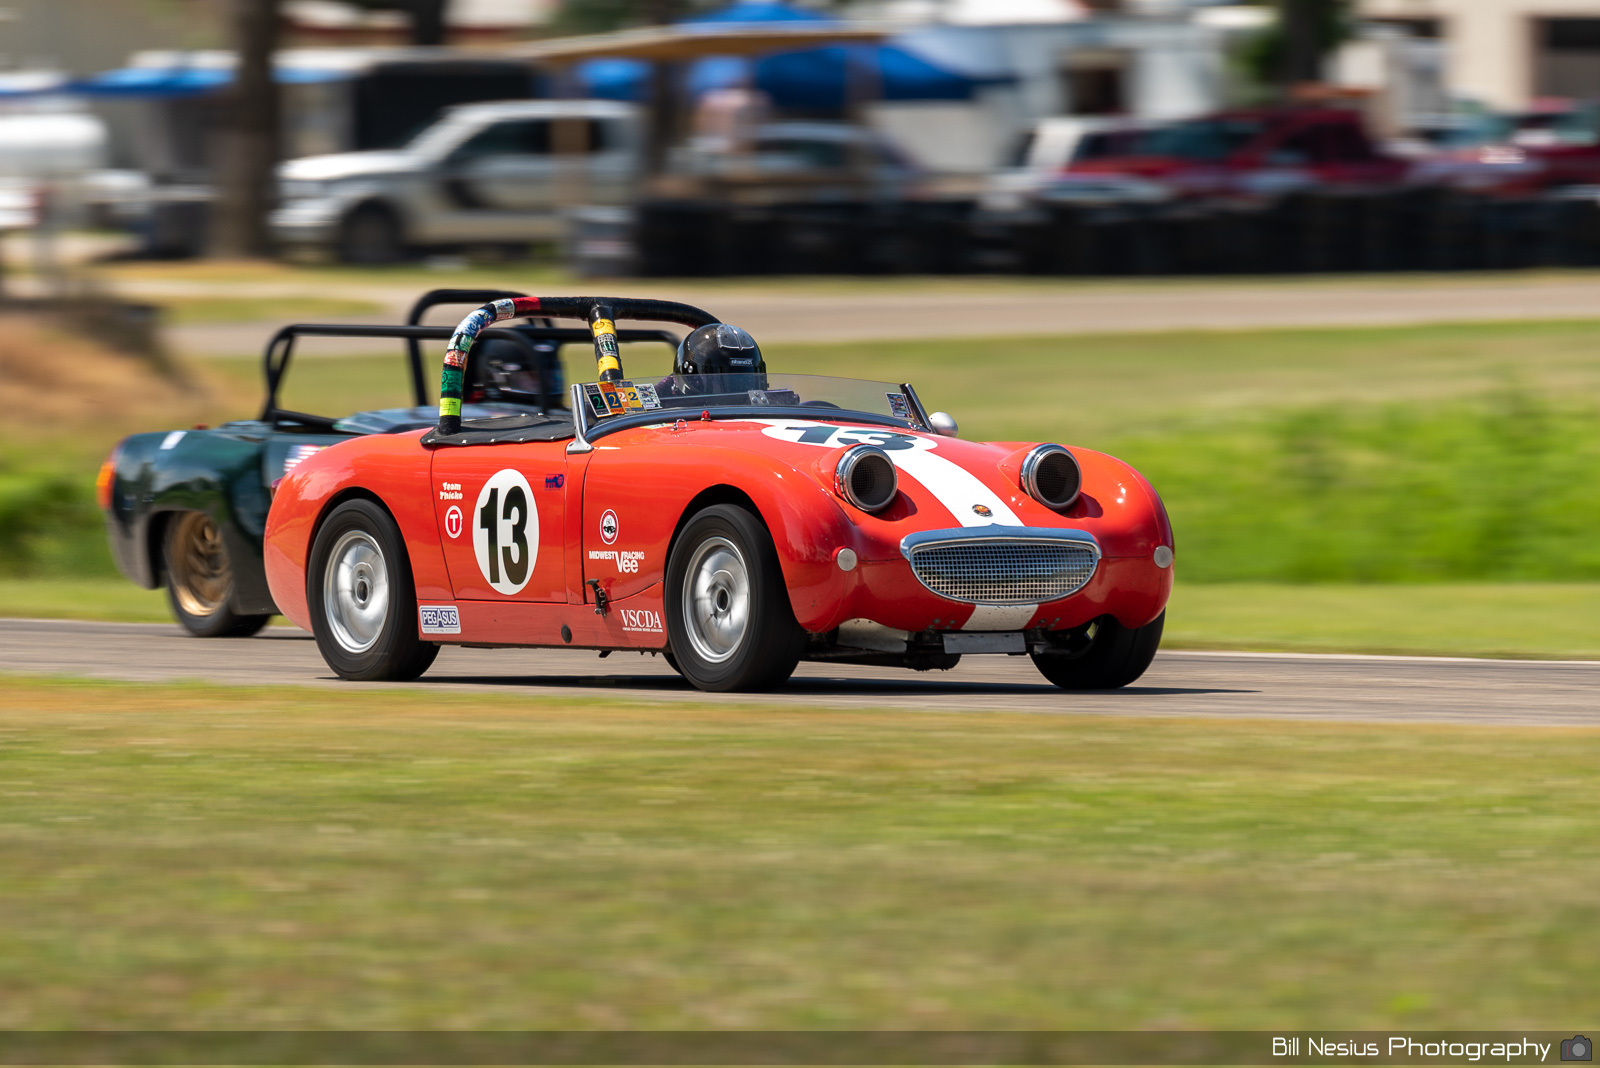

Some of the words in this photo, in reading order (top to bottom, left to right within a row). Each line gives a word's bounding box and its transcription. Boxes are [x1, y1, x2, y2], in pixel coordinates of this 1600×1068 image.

[592, 396, 604, 408] 2
[608, 394, 619, 406] 2
[618, 392, 628, 402] 2
[628, 392, 639, 401] 2
[785, 425, 918, 451] 13
[442, 482, 461, 491] Team
[450, 514, 458, 531] T
[480, 486, 529, 585] 13
[588, 550, 615, 560] MIDWEST
[623, 551, 645, 560] RACING
[614, 550, 639, 573] Vee
[422, 609, 457, 625] PEGASUS
[620, 609, 663, 628] VSCDA
